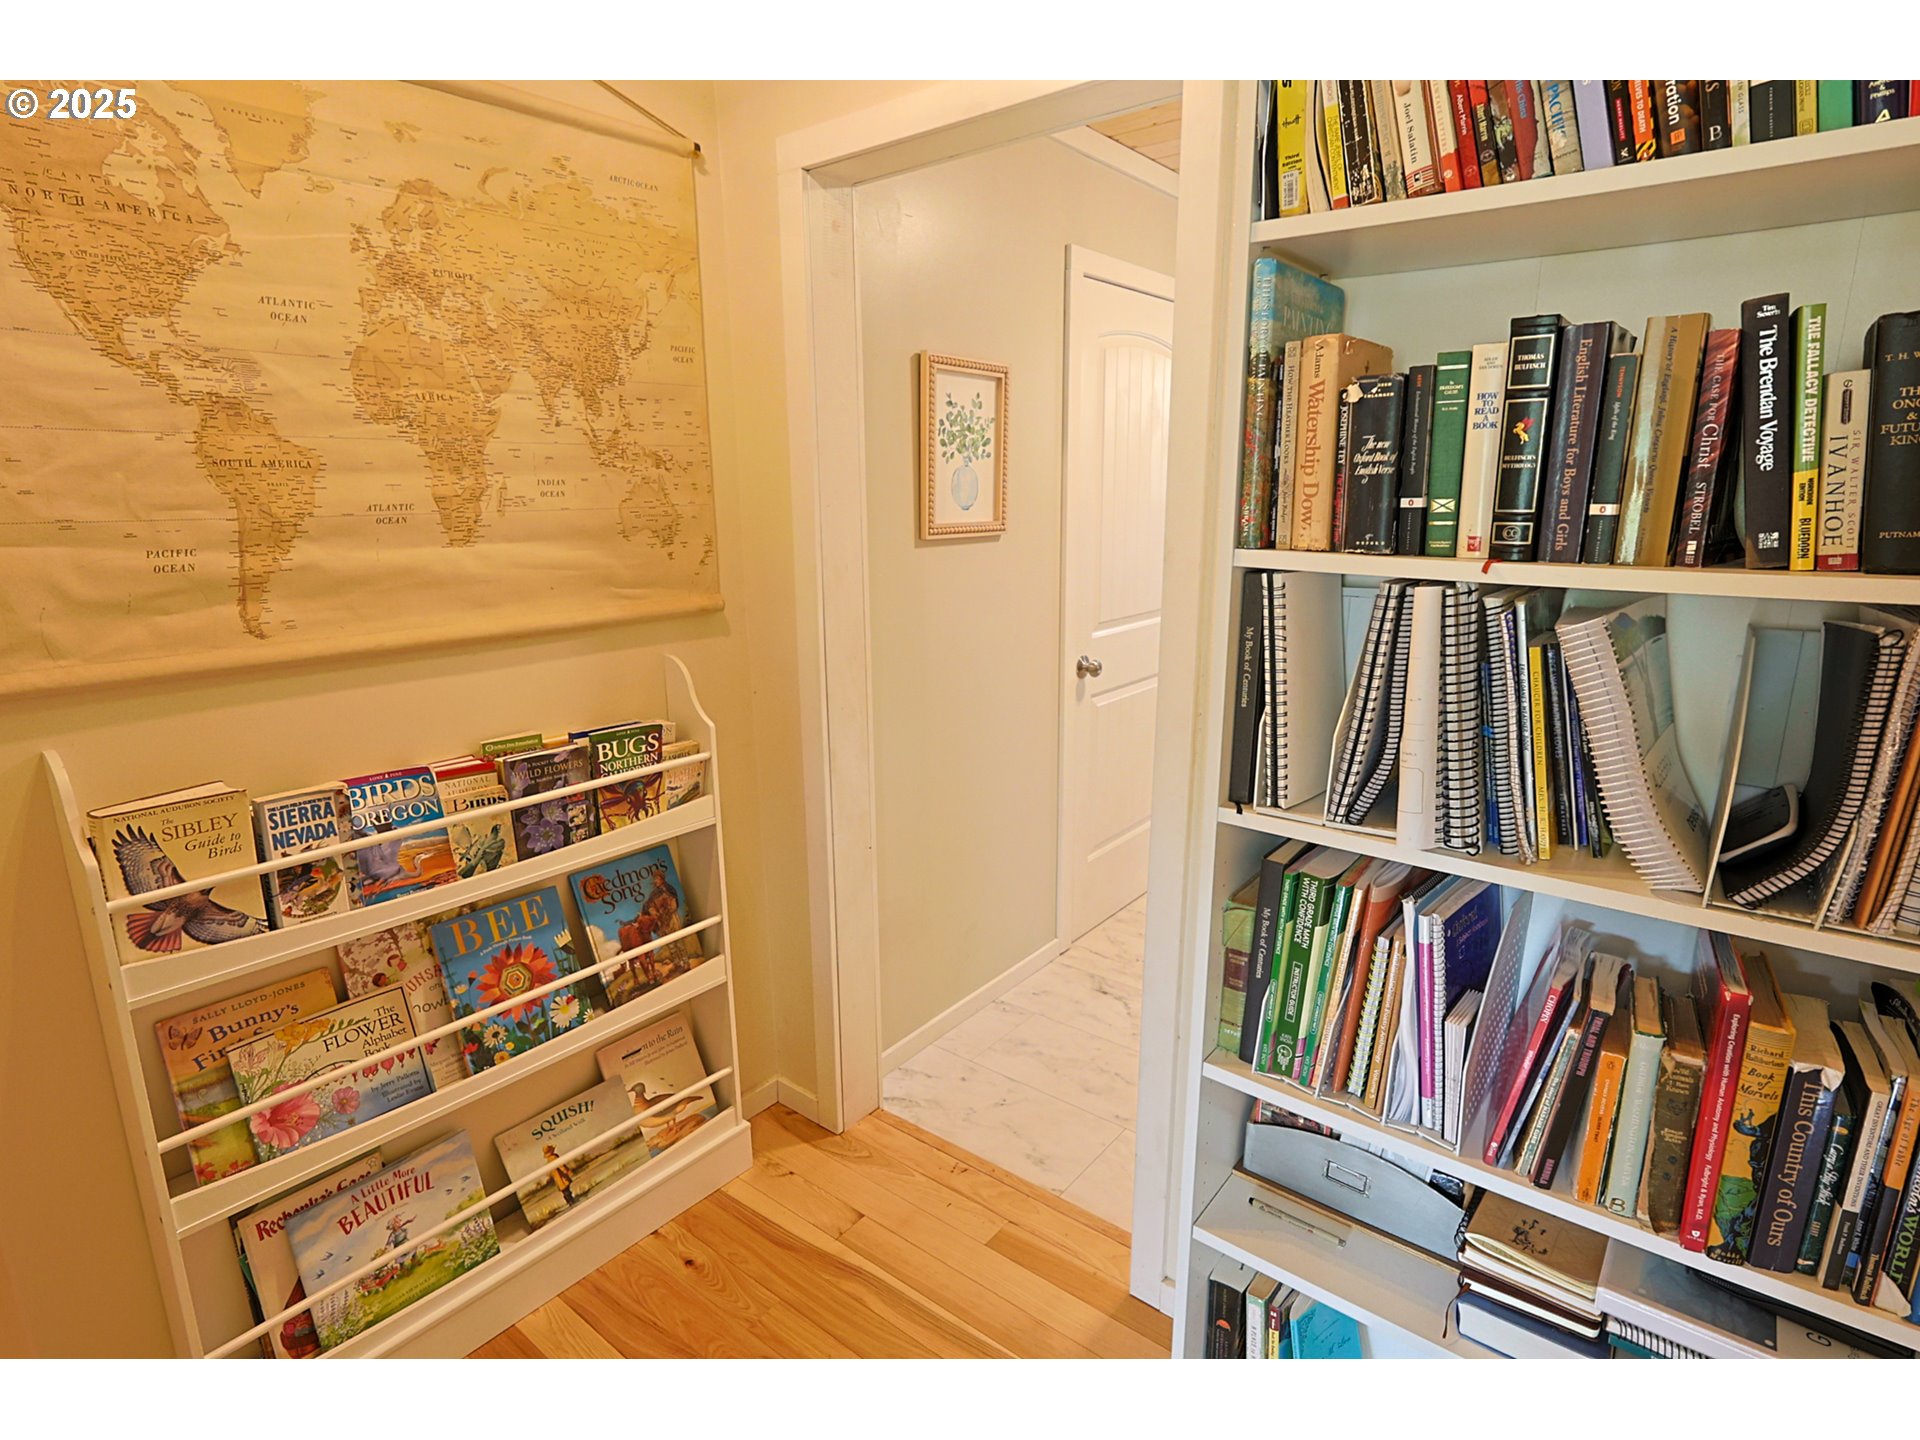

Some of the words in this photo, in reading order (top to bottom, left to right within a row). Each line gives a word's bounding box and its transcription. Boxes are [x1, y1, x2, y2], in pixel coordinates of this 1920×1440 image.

[1404, 103, 1414, 125] Joel
[1407, 126, 1418, 164] Salatin
[8, 183, 85, 206] NORTH
[102, 201, 194, 224] AMERICA
[432, 268, 475, 282] EUROPE
[257, 295, 317, 311] ATLANTIC
[1756, 308, 1781, 319] Severin
[1762, 304, 1777, 313] Tim
[269, 312, 309, 324] OCEAN
[1807, 316, 1822, 337] THE
[670, 344, 696, 354] PACIFIC
[1759, 325, 1779, 358] The
[672, 356, 694, 364] OCEAN
[1314, 340, 1324, 379] Adams
[1513, 362, 1546, 371] BULFINCH
[1517, 353, 1545, 362] THOMAS
[1574, 339, 1593, 382] English
[1715, 354, 1725, 374] THE
[1804, 338, 1821, 396] FALLACY
[414, 392, 454, 402] AFRICA
[1477, 392, 1499, 401] HOW
[1711, 375, 1721, 399] CASE
[1759, 359, 1779, 420] Brendan
[1474, 408, 1500, 416] READ
[1568, 383, 1588, 445] Literature
[1707, 402, 1718, 421] FOR
[1907, 412, 1918, 421] &
[1300, 380, 1325, 476] Watership
[1339, 404, 1349, 448] JOSEPHINE
[1472, 421, 1499, 430] BOOK
[1801, 396, 1819, 463] DETECTIVE
[1361, 434, 1377, 451] The
[1376, 441, 1392, 449] new
[1697, 424, 1719, 469] Christ
[1755, 420, 1779, 472] Voyage
[1849, 430, 1861, 451] SIR
[212, 458, 252, 469] SOUTH
[260, 459, 313, 469] AMERICA
[1337, 449, 1347, 465] TEY
[1353, 451, 1375, 464] Oxford
[1373, 451, 1390, 462] Book
[1389, 451, 1398, 464] of
[1565, 446, 1580, 466] for
[536, 479, 566, 487] INDIAN
[1354, 463, 1380, 484] English
[1378, 465, 1396, 475] Verse
[1563, 467, 1577, 496] Boys
[1848, 456, 1860, 506] WALTER
[1821, 434, 1849, 547] IVANHOE
[366, 503, 415, 513] ATLANTIC
[1300, 482, 1320, 537] Dow
[1560, 498, 1571, 521] and
[1689, 482, 1707, 535] STROBEL
[375, 516, 408, 525] OCEAN
[1846, 512, 1857, 549] SCOTT
[1555, 521, 1570, 551] Girls
[1797, 518, 1812, 560] BLUEDORN
[146, 549, 197, 559] PACIFIC
[153, 564, 196, 574] OCEAN
[1246, 626, 1254, 638] My
[1244, 639, 1254, 659] Book
[1243, 660, 1252, 671] of
[1241, 673, 1251, 708] Centuries
[1533, 671, 1542, 708] CHAUCER
[1534, 709, 1542, 726] FOR
[596, 733, 660, 762] BUGS
[1535, 727, 1544, 766] CHILDREN
[513, 768, 541, 779] WILD
[541, 759, 584, 775] FLOWERS
[600, 752, 659, 773] NORTHERN
[350, 775, 436, 811] BIRDS
[444, 775, 491, 789] NATIONAL
[113, 809, 158, 824] NATIONAL
[160, 802, 202, 814] AUDUBON
[203, 795, 236, 806] SOCIETY
[453, 792, 506, 812] BIRDS
[161, 818, 174, 826] The
[268, 802, 336, 831] SIERRA
[352, 799, 440, 831] OREGON
[161, 813, 239, 842] SIBLEY
[271, 820, 338, 851] NEVADA
[184, 834, 226, 851] Guide
[230, 832, 241, 842] to
[208, 844, 243, 860] Birds
[583, 857, 668, 901] Caedmon's
[1300, 877, 1311, 899] WITH
[603, 884, 644, 915] Song
[1308, 880, 1319, 903] THIRD
[1262, 907, 1271, 919] My
[1294, 899, 1307, 944] CONFIDENCE
[1304, 903, 1315, 928] GRADE
[448, 895, 550, 958] BEE
[1260, 920, 1270, 937] Book
[1258, 938, 1267, 948] of
[1300, 929, 1312, 949] MATH
[1255, 948, 1267, 979] Centuries
[1291, 967, 1301, 998] INSTRUCTOR
[192, 1005, 227, 1024] SALLY
[231, 981, 306, 1011] LLOYD-JONES
[374, 1004, 396, 1017] The
[1287, 998, 1296, 1016] GUIDE
[1540, 994, 1557, 1024] CHOPIN
[207, 1004, 300, 1043] Bunny's
[322, 1012, 404, 1053] FLOWER
[1593, 1017, 1605, 1034] TRIAL
[1727, 1013, 1741, 1040] Exploring
[362, 1026, 408, 1049] Alphabet
[656, 1034, 667, 1044] the
[666, 1026, 684, 1039] Rain
[1585, 1033, 1599, 1048] AND
[364, 1043, 390, 1058] Book
[1724, 1040, 1736, 1063] Creation
[1751, 1045, 1785, 1058] Richard
[1576, 1048, 1594, 1076] TRIUMPH
[1722, 1064, 1731, 1077] with
[1636, 1062, 1648, 1094] GEORGE
[1747, 1067, 1775, 1081] Book
[1719, 1077, 1728, 1097] Human
[1740, 1084, 1778, 1100] Marvels
[1757, 1081, 1771, 1091] of
[1713, 1097, 1724, 1122] Anatomy
[1798, 1081, 1824, 1118] This
[530, 1099, 596, 1141] SQUISH!
[1627, 1098, 1642, 1156] WASHINGTON
[1711, 1123, 1719, 1133] and
[1705, 1133, 1718, 1162] Physiology
[1777, 1120, 1815, 1188] Country
[1823, 1143, 1844, 1164] Carry
[1621, 1157, 1633, 1187] CARVER
[1701, 1165, 1712, 1189] Fulbright
[1820, 1171, 1840, 1187] Big
[350, 1193, 360, 1204] A
[360, 1179, 391, 1199] Little
[392, 1167, 417, 1183] More
[1817, 1184, 1834, 1206] Stick
[336, 1171, 435, 1236] BEAUTIFUL
[1609, 1198, 1626, 1213] B
[1697, 1193, 1706, 1209] Ryan,
[1781, 1188, 1797, 1210] of
[1696, 1208, 1704, 1221] M.D.
[1767, 1211, 1794, 1249] Ours
